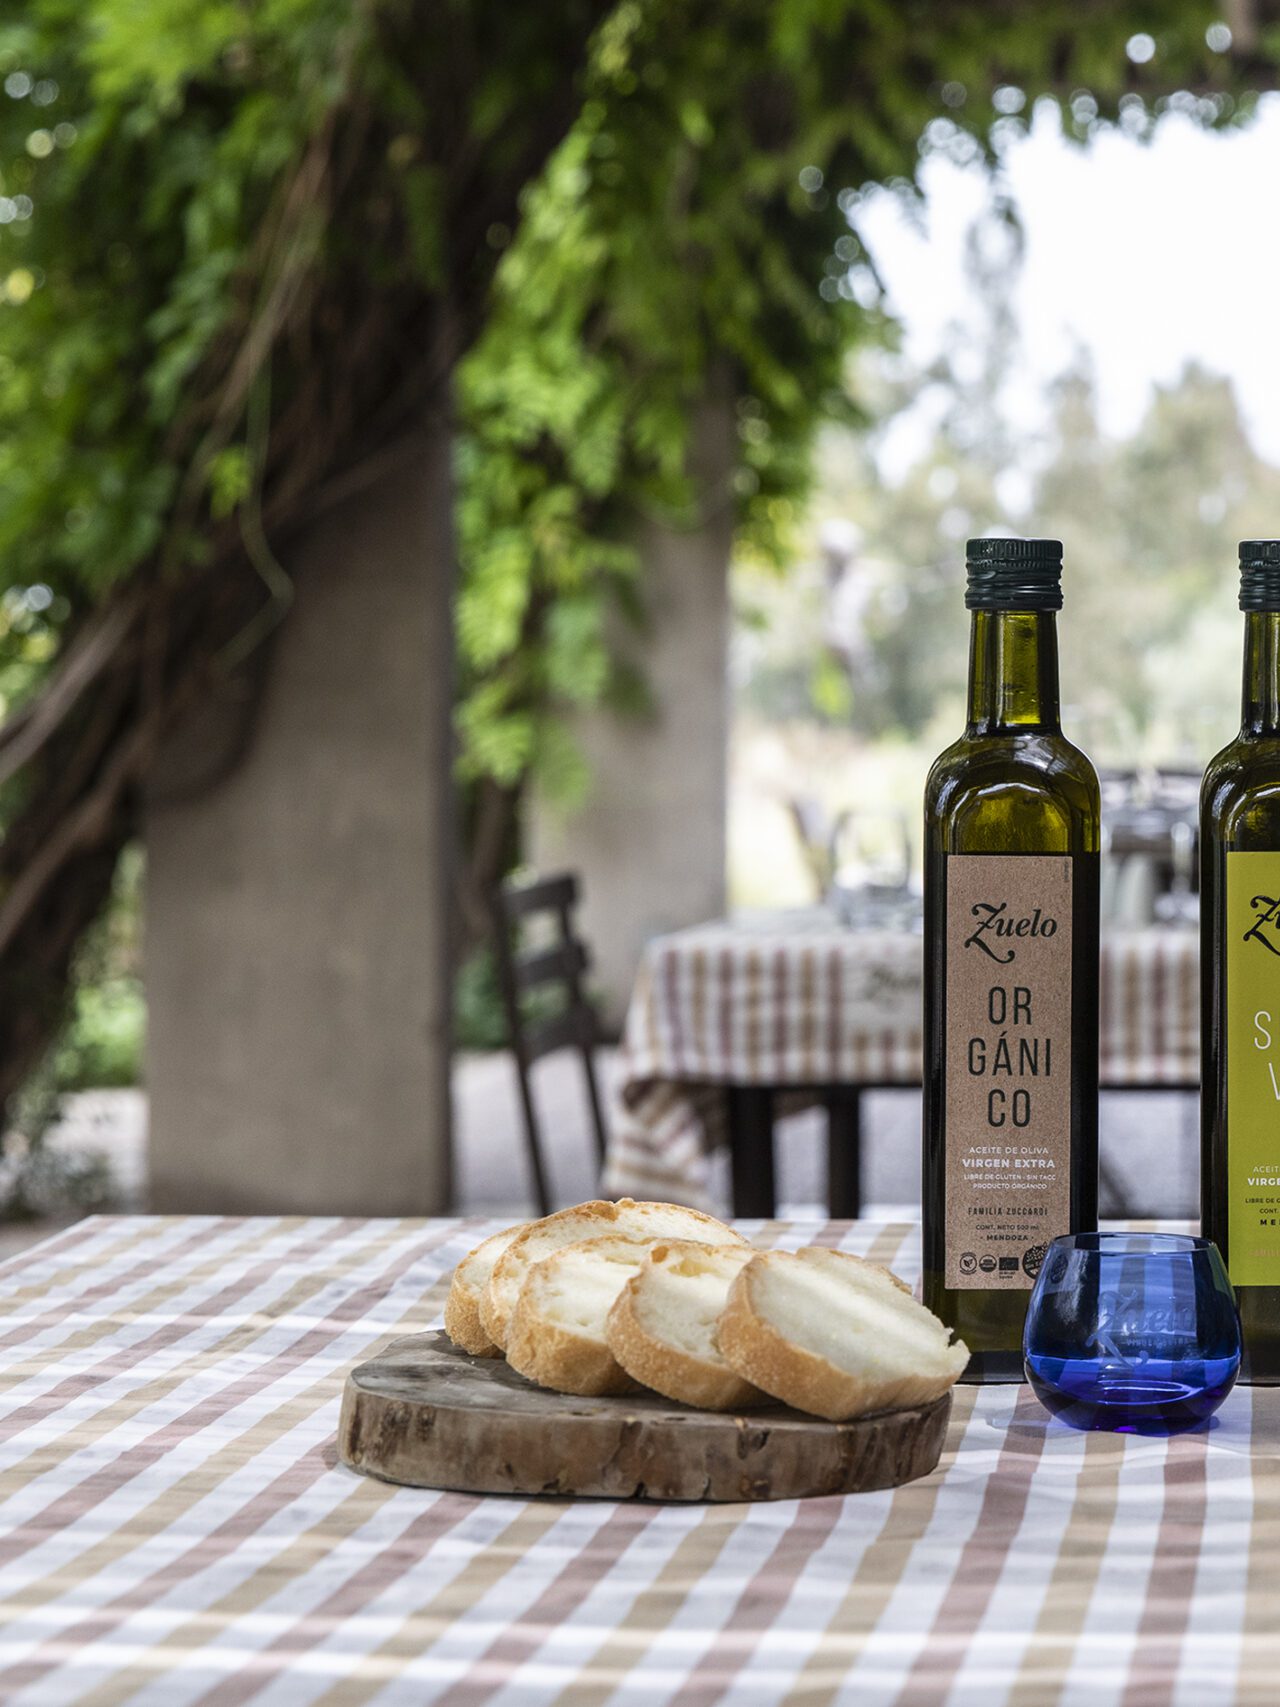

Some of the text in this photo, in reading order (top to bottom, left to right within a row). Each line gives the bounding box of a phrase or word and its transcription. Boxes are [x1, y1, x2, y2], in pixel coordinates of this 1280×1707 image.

[964, 902, 1058, 964] Zuelo
[988, 986, 1032, 1025] OR
[967, 1031, 1051, 1077] GÁNI
[987, 1088, 1031, 1128] CO
[962, 1158, 1056, 1168] VIRGEN EXTRA
[969, 1146, 1049, 1155] ACEITE DE OLIVA
[968, 1207, 1049, 1216] FAMILIA ZUCCARDI
